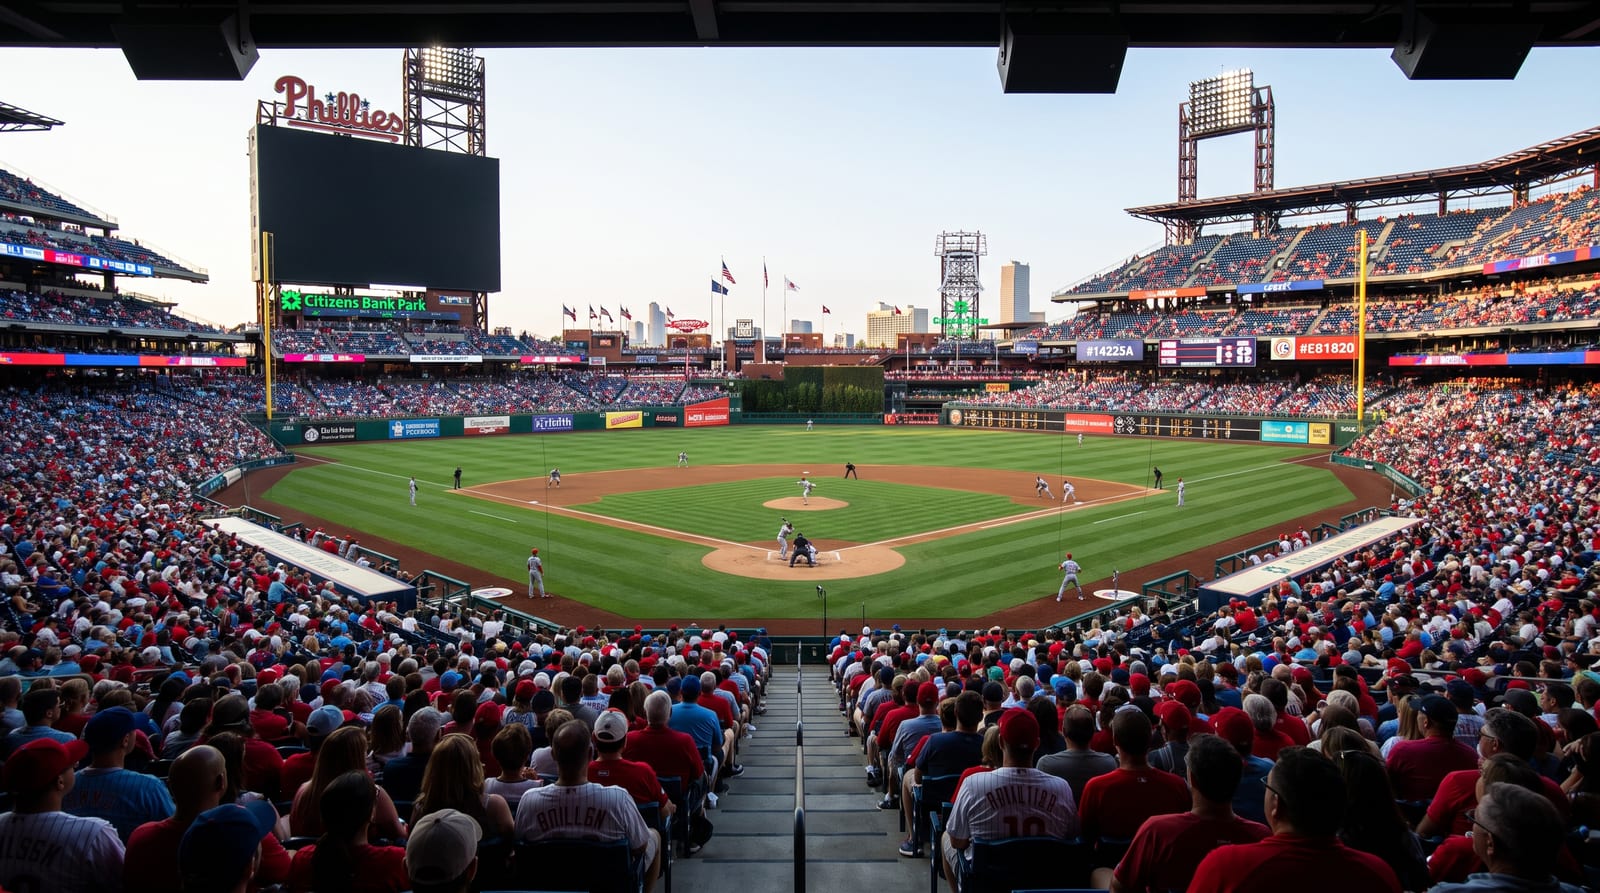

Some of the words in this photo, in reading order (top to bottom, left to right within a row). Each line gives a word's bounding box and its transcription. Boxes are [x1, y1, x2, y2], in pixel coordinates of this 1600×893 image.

[274, 75, 403, 132] Phillies
[304, 294, 359, 309] Citizens
[362, 296, 394, 310] Bank
[397, 297, 427, 311] Park
[1086, 345, 1134, 357] #14225A
[1299, 342, 1355, 355] #E81820
